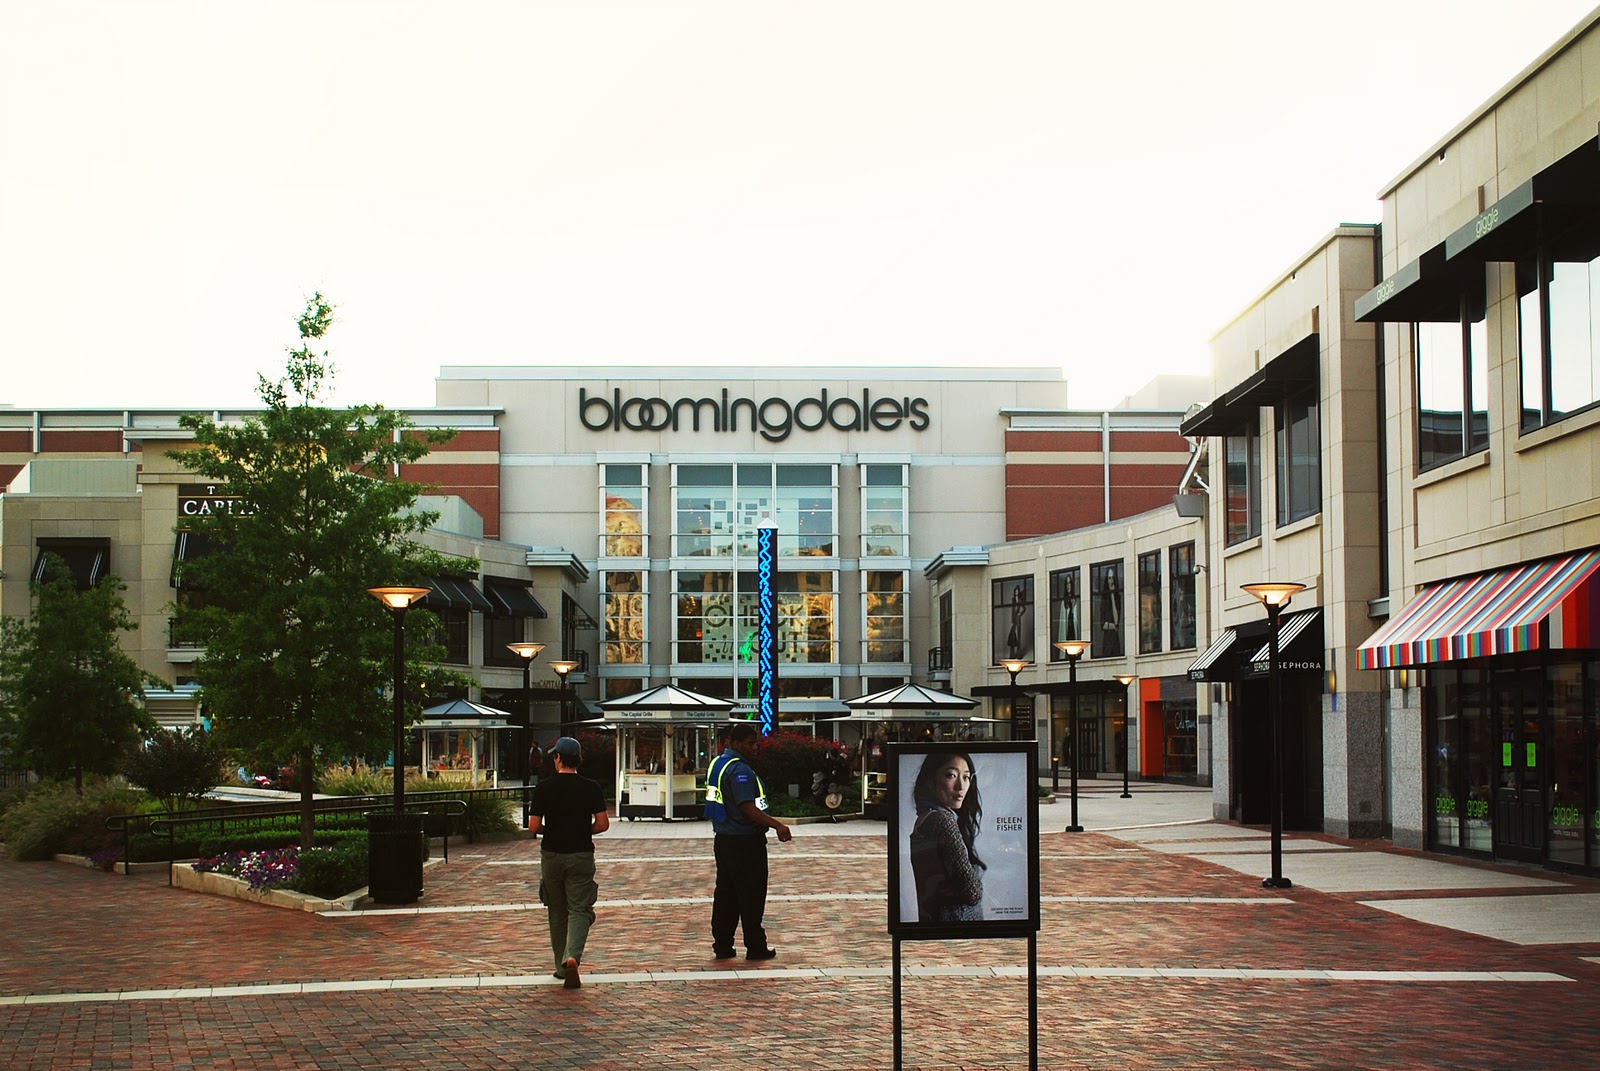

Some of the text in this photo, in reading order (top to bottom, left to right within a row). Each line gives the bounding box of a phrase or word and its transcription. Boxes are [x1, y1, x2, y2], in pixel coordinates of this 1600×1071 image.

[1475, 208, 1499, 238] giggle
[1376, 279, 1395, 305] giggle
[579, 387, 931, 443] bloomingdale's
[183, 500, 270, 515] CAPI
[996, 816, 1023, 824] EILEEN
[1552, 803, 1579, 826] giggle
